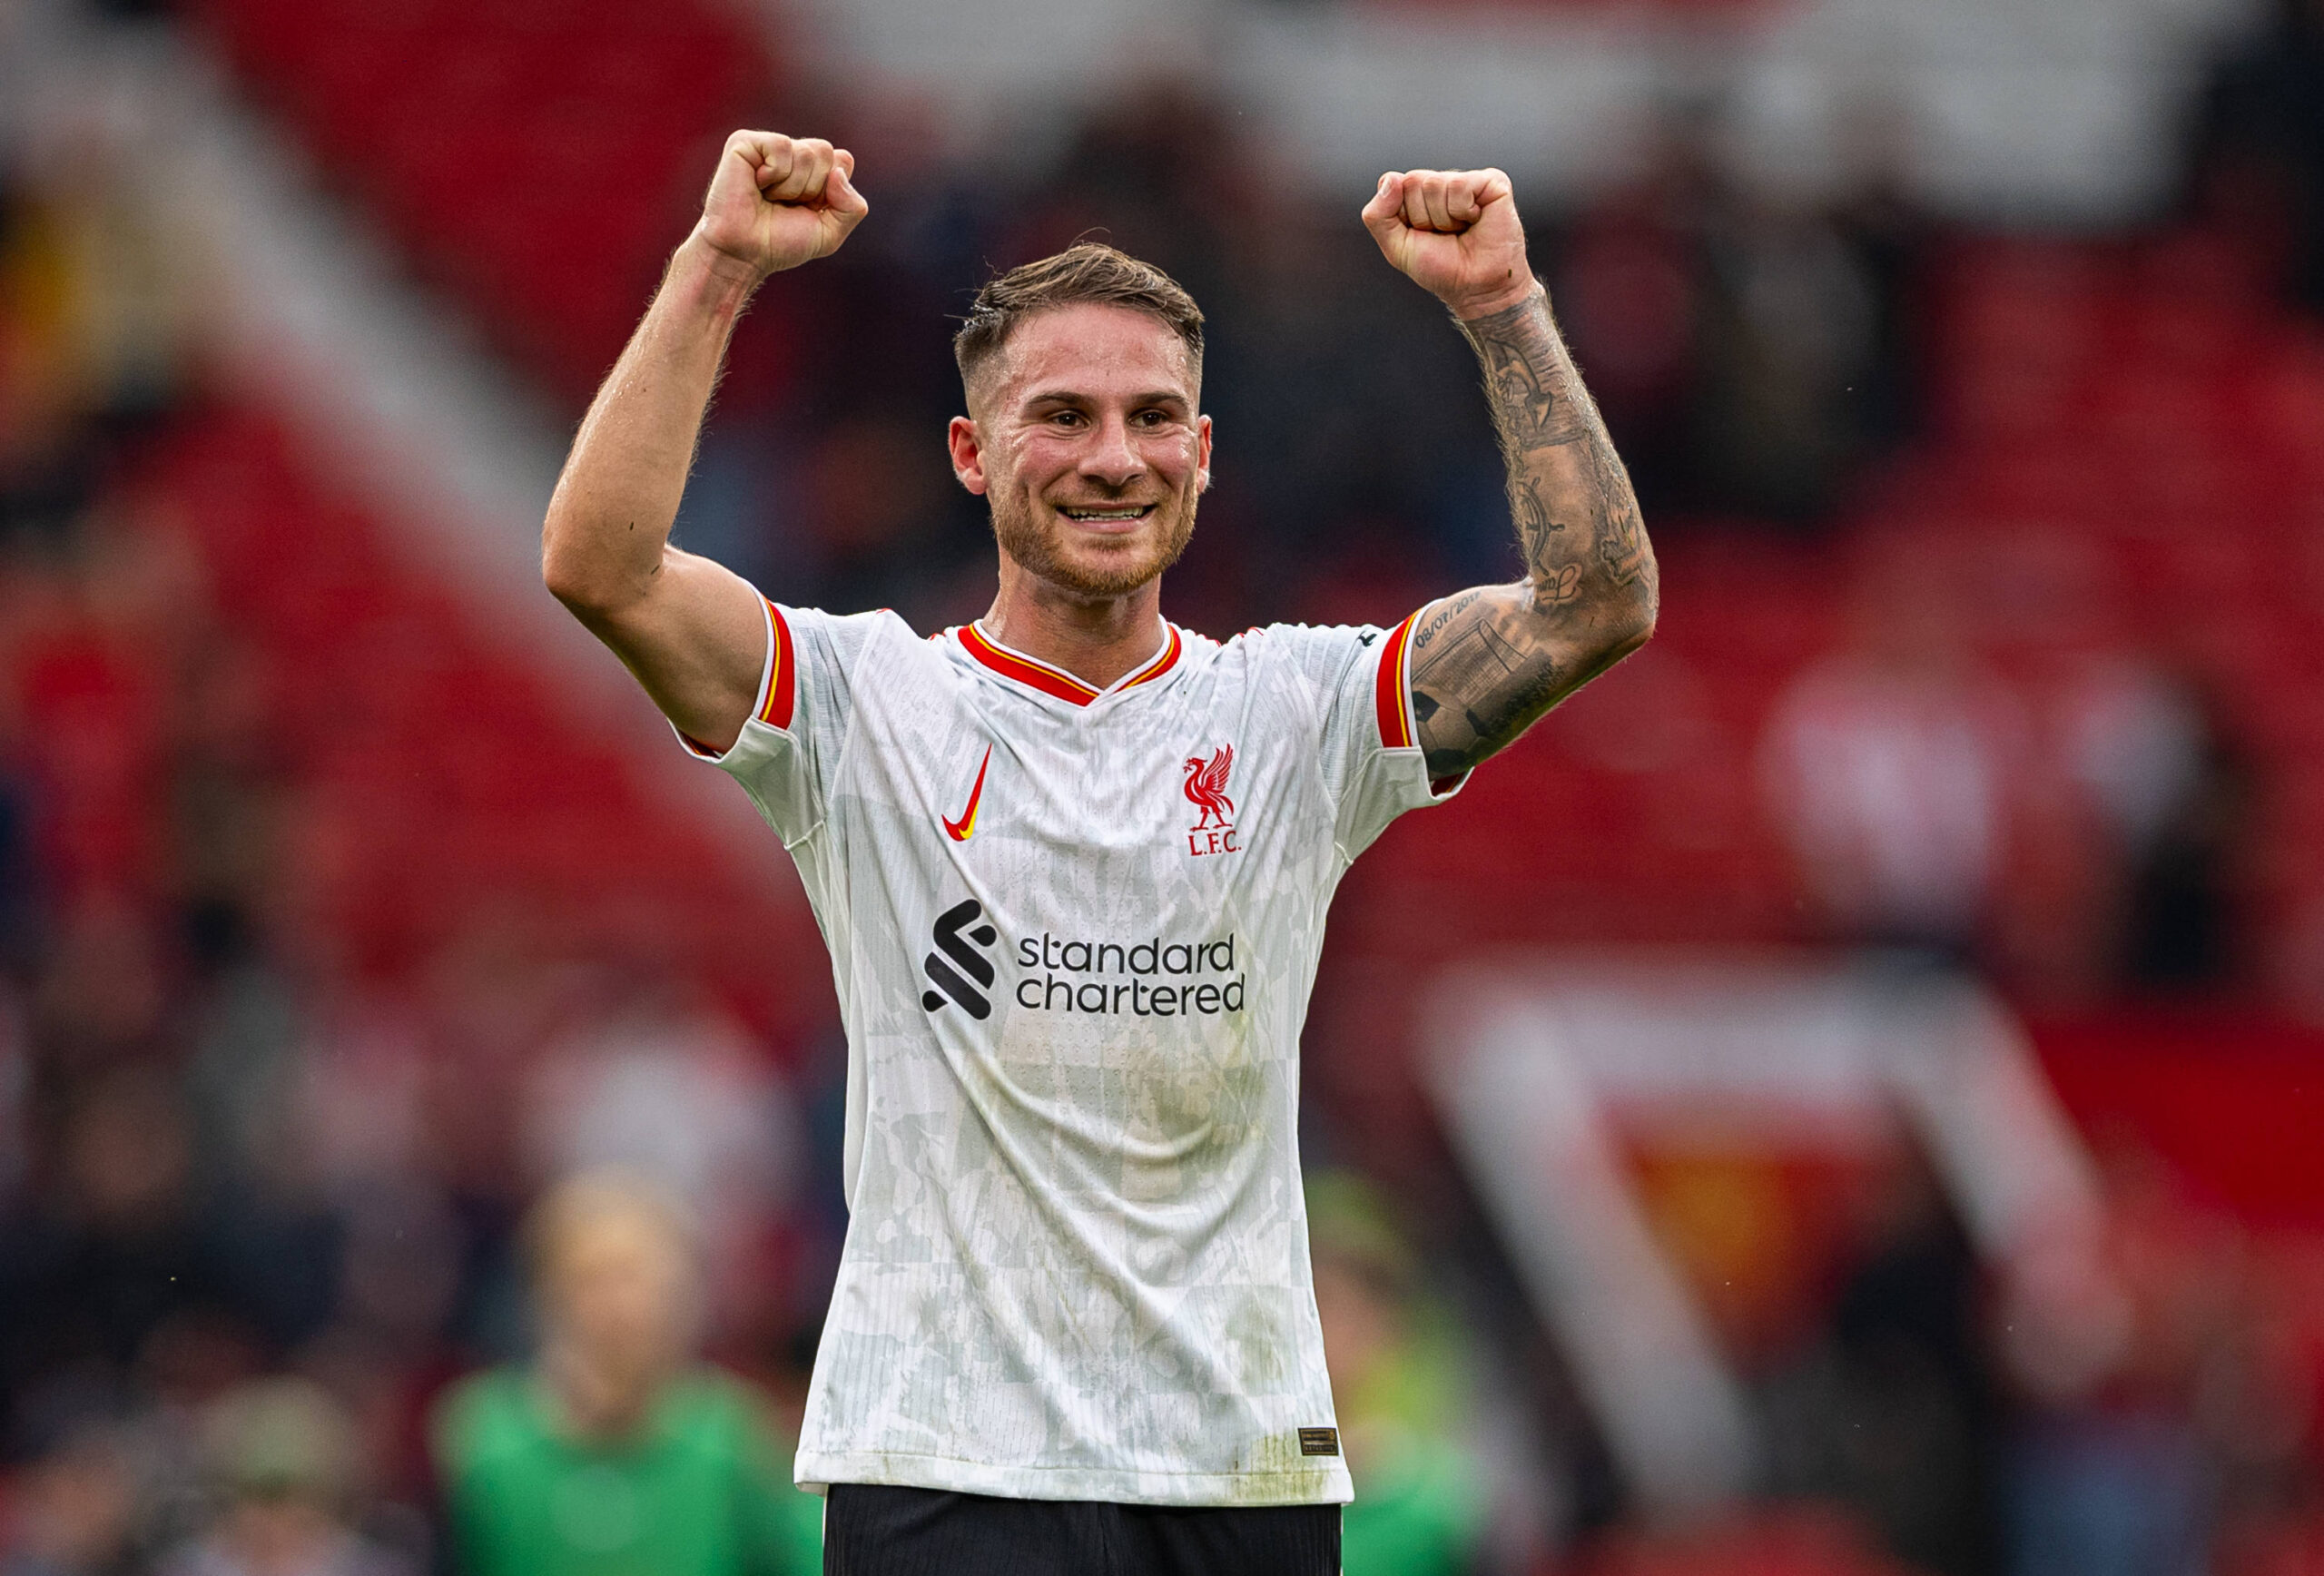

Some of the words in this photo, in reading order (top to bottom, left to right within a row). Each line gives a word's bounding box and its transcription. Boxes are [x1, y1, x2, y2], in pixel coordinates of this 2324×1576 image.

[1188, 830, 1242, 856] L.F.C.
[1018, 931, 1235, 974] standard
[1016, 972, 1246, 1017] chartered
